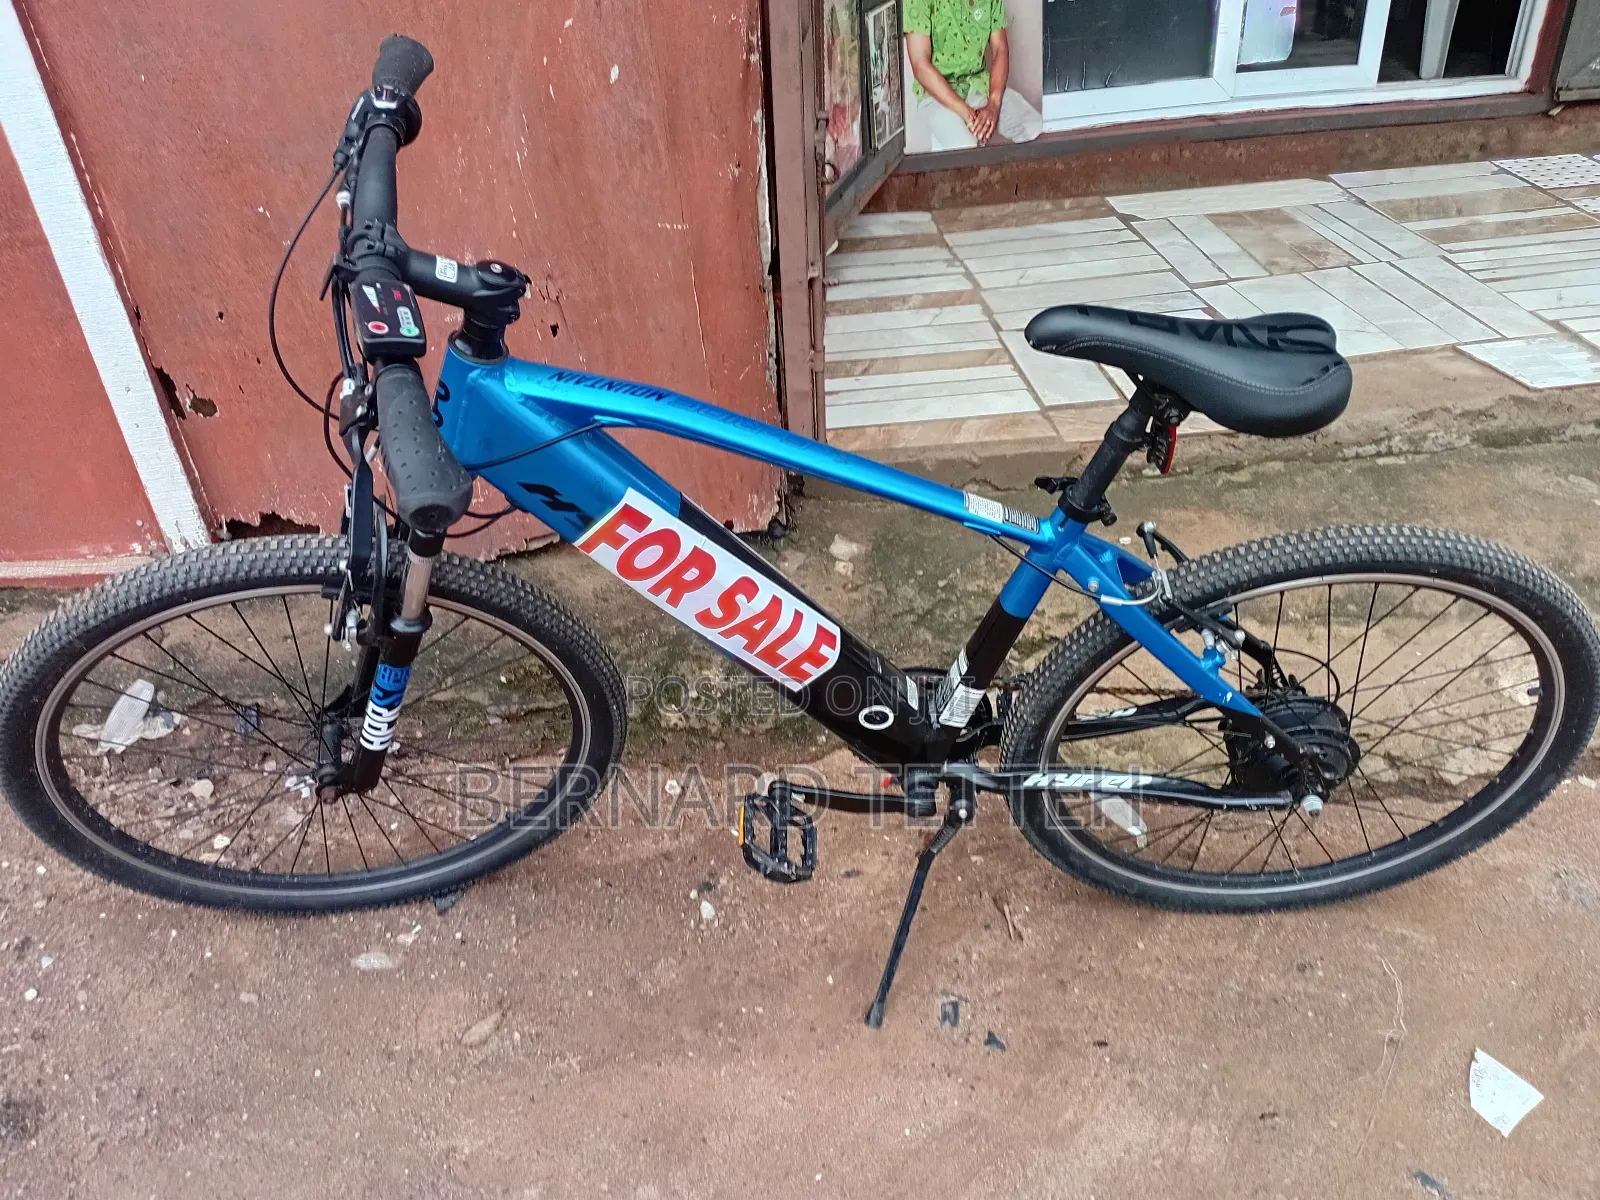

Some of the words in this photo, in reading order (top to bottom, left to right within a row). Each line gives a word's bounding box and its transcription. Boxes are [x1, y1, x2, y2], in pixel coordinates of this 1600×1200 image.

[548, 371, 667, 404] MOUNTAIN
[578, 502, 717, 608] FOR
[694, 575, 838, 685] SALE
[1022, 771, 1153, 790] HYPER
